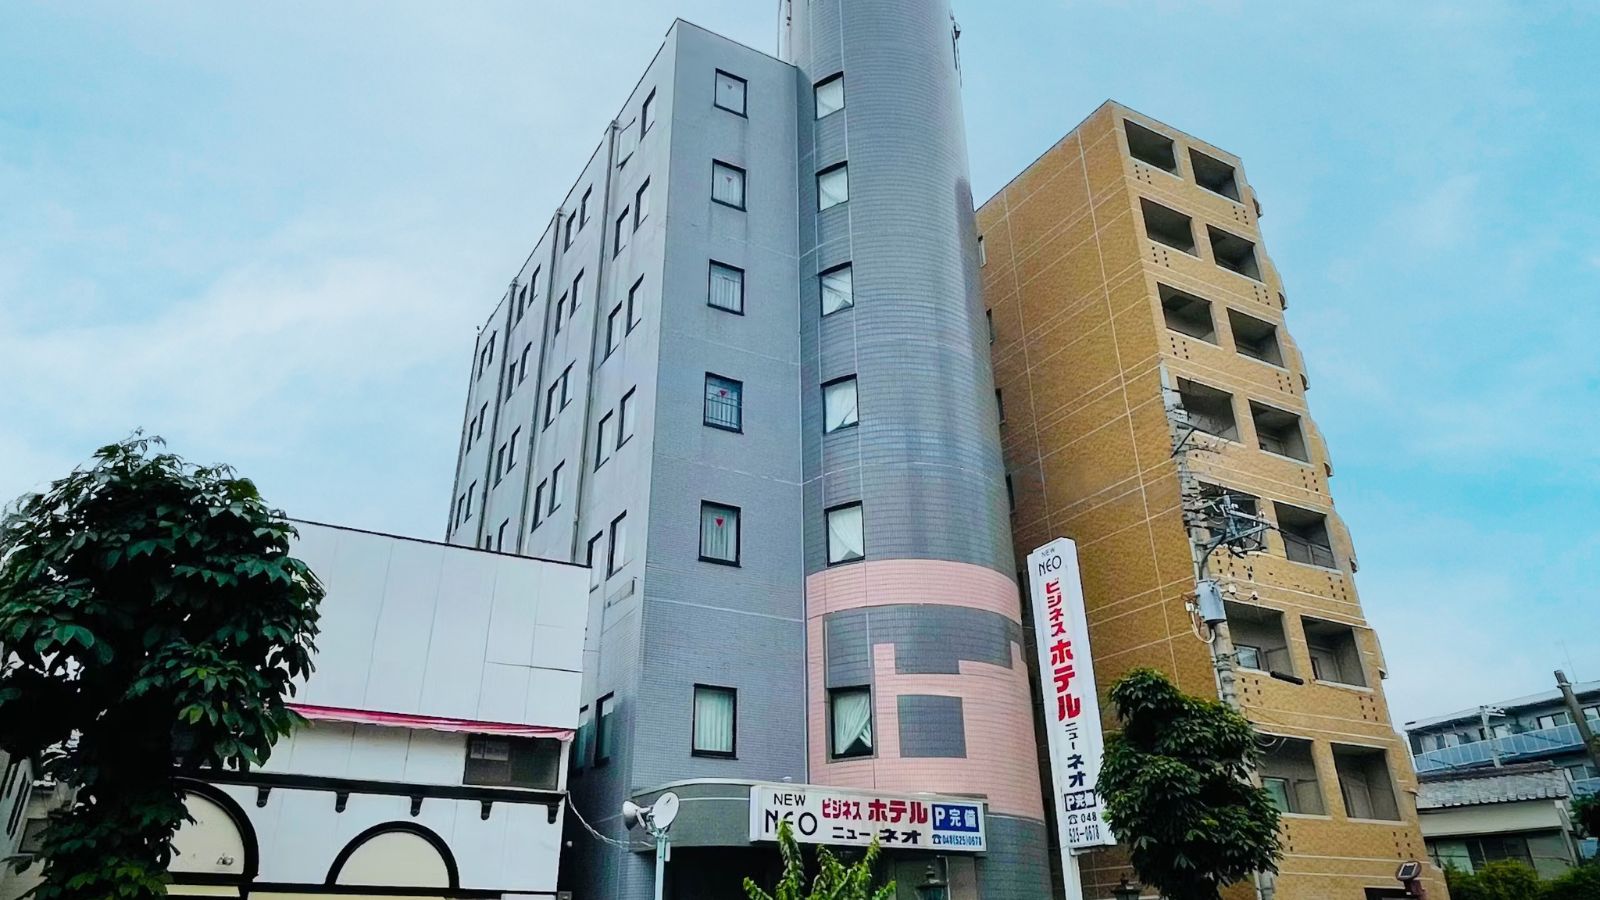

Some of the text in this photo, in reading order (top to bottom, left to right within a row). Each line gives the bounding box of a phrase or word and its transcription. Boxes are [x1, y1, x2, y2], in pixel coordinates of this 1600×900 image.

[1041, 547, 1056, 556] NEW
[1038, 555, 1062, 577] NEO
[1045, 576, 1081, 722] ビジネスホテル
[1065, 722, 1087, 788] ニューネオ
[773, 793, 806, 807] NEW
[1080, 811, 1097, 824] 048
